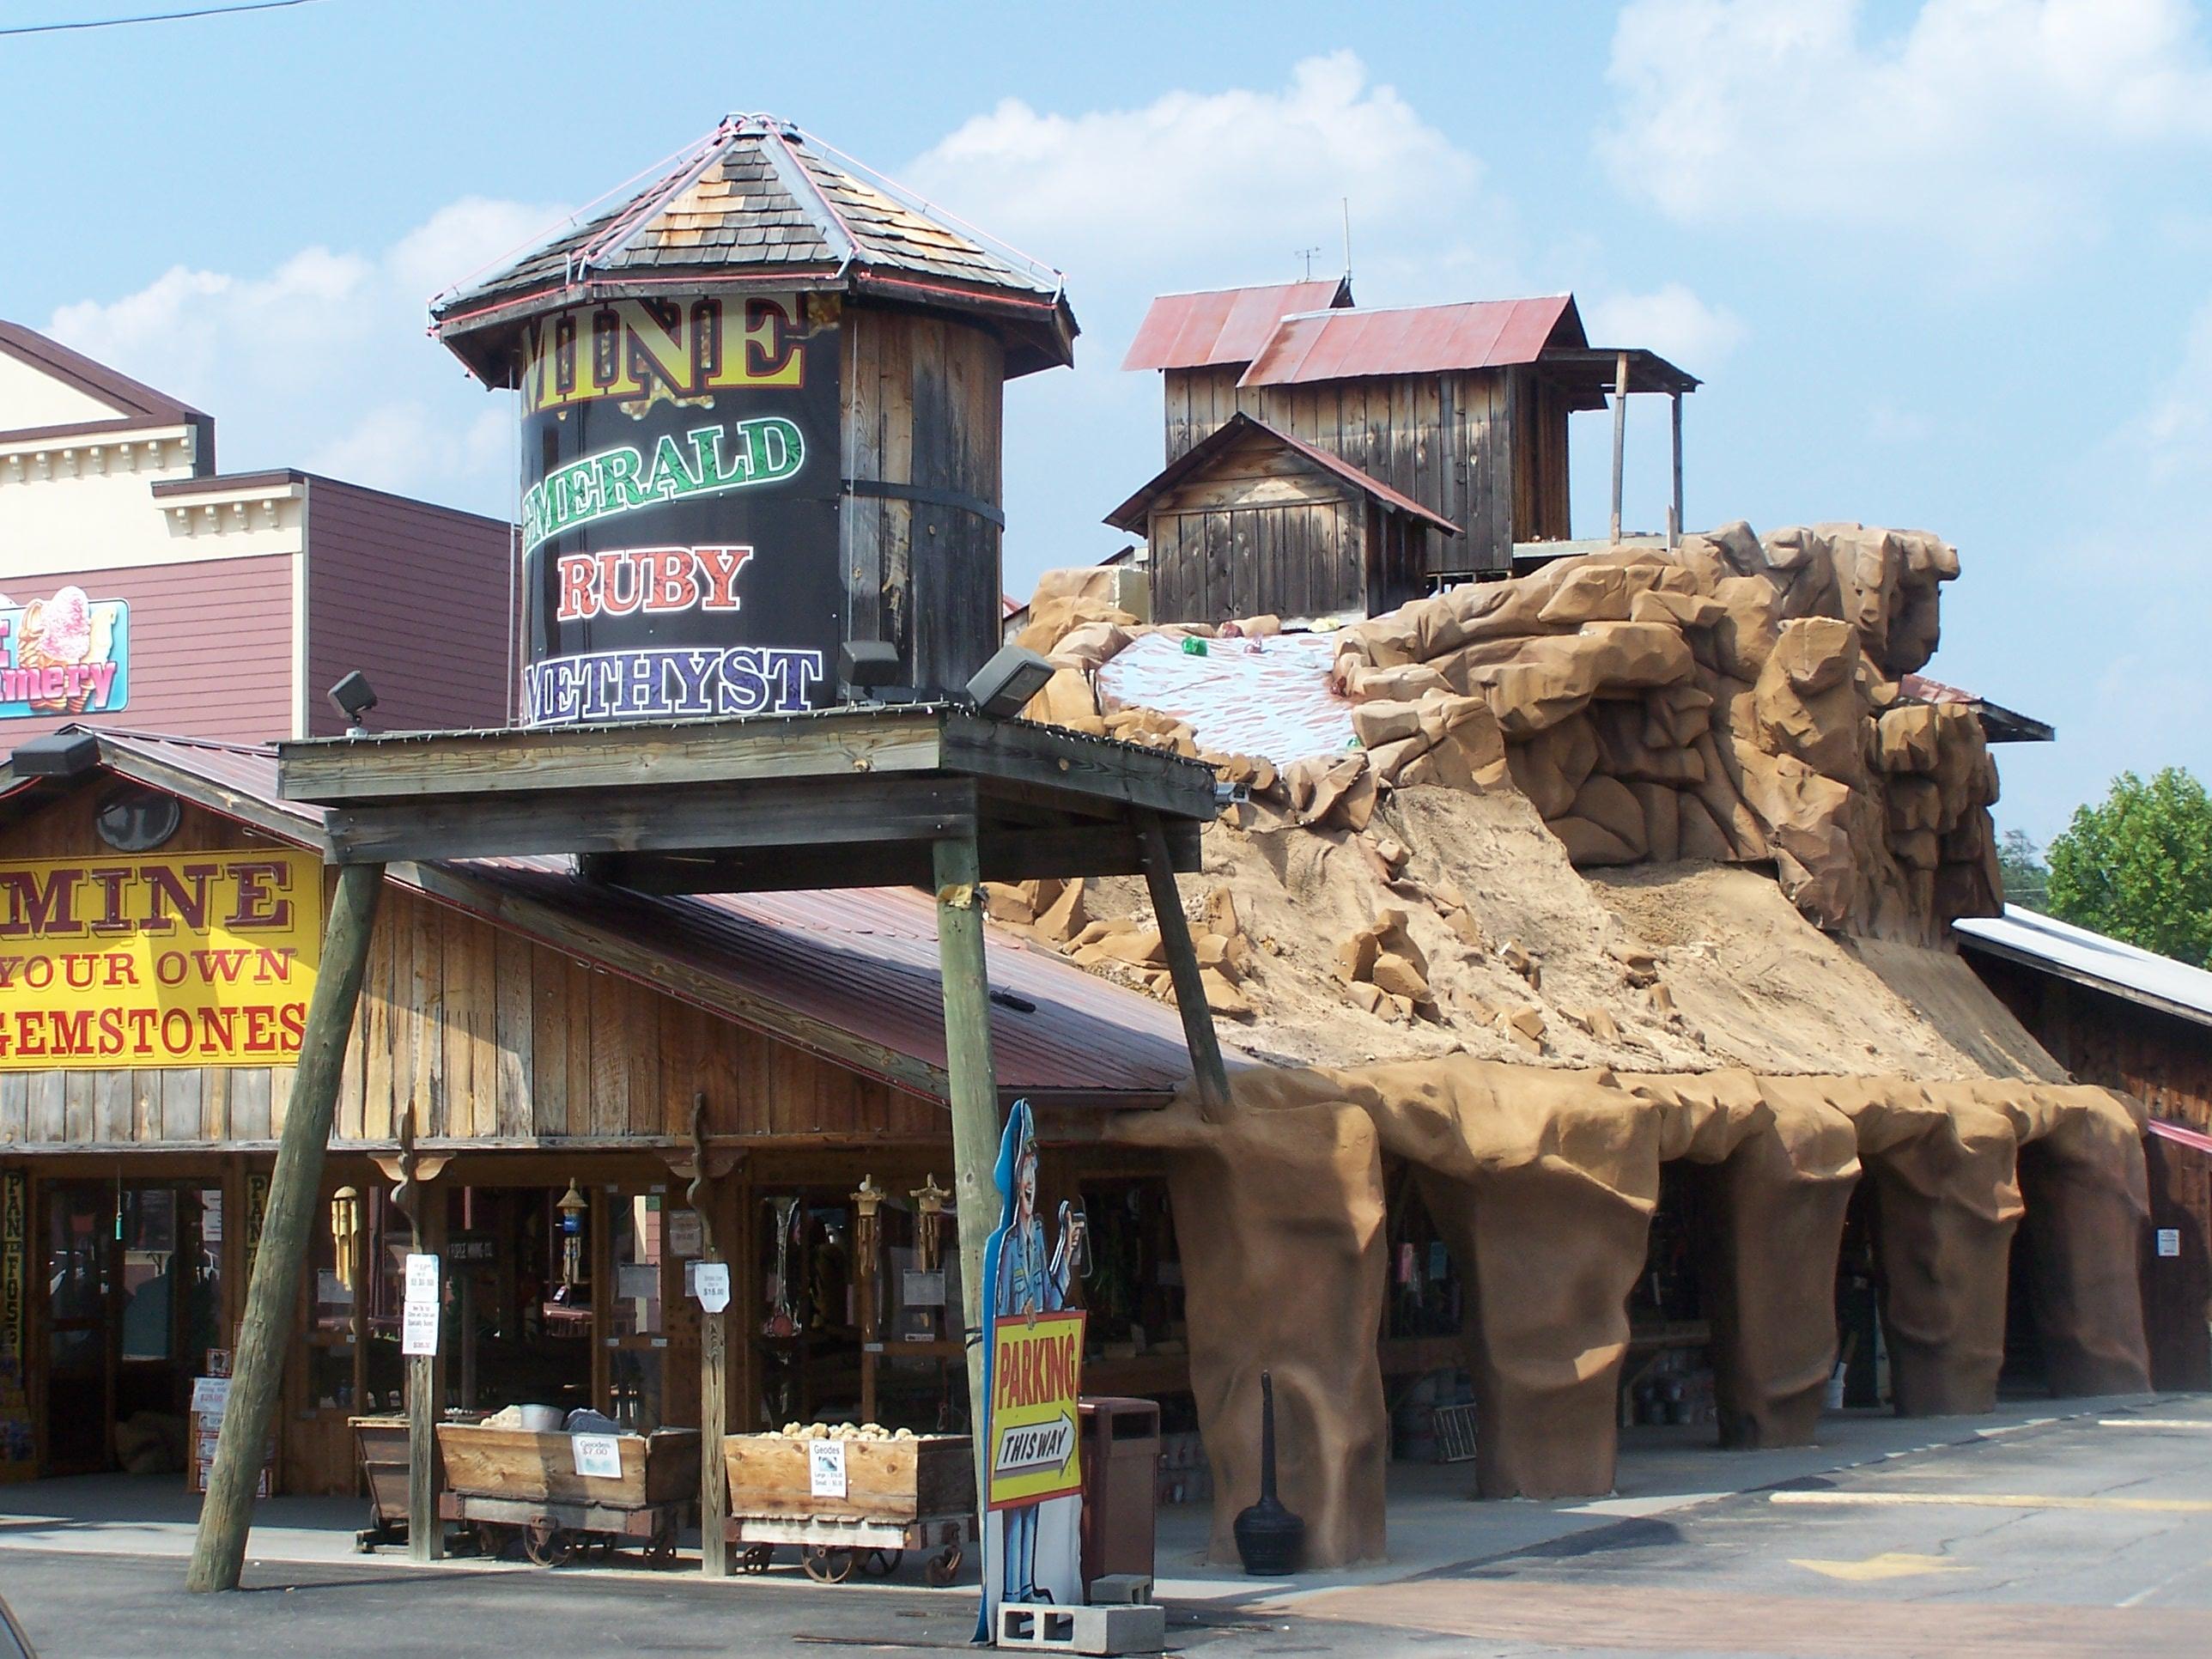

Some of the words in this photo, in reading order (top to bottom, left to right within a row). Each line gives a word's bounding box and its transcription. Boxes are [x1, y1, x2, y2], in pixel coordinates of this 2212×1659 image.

[520, 294, 805, 417] MINE
[522, 416, 805, 556] EMERALD
[557, 546, 753, 622] RUBY
[0, 660, 117, 709] mery
[521, 647, 823, 726] METHYST
[0, 861, 294, 940] MINE
[0, 953, 139, 990] YOUR
[156, 948, 296, 987] OWN
[999, 1334, 1075, 1410] PARKING
[814, 1444, 840, 1455] Geodes
[1003, 1433, 1037, 1462] THIS
[1037, 1426, 1067, 1458] WAY
